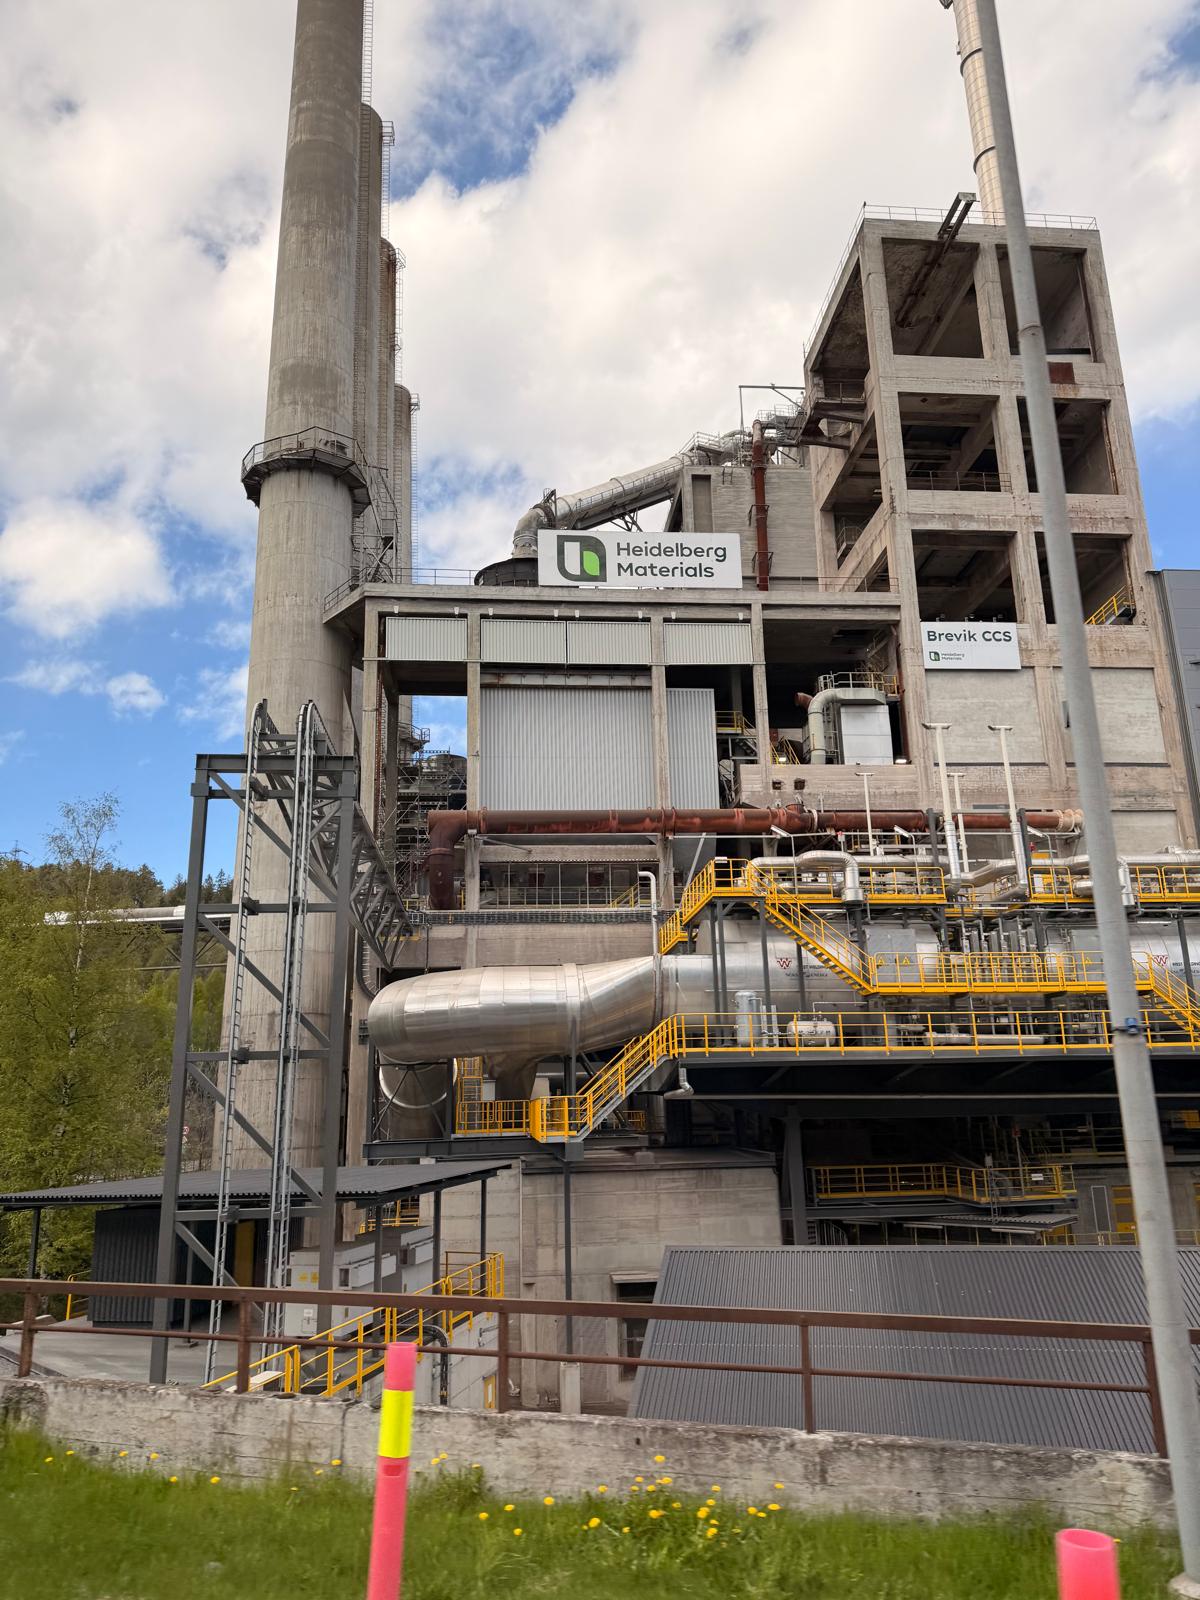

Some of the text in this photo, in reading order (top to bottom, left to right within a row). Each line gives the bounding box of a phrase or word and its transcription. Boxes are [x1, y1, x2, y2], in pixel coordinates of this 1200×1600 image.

[616, 541, 727, 563] Heidelberg
[617, 562, 715, 578] Materials
[926, 629, 1013, 642] Brevik CCS
